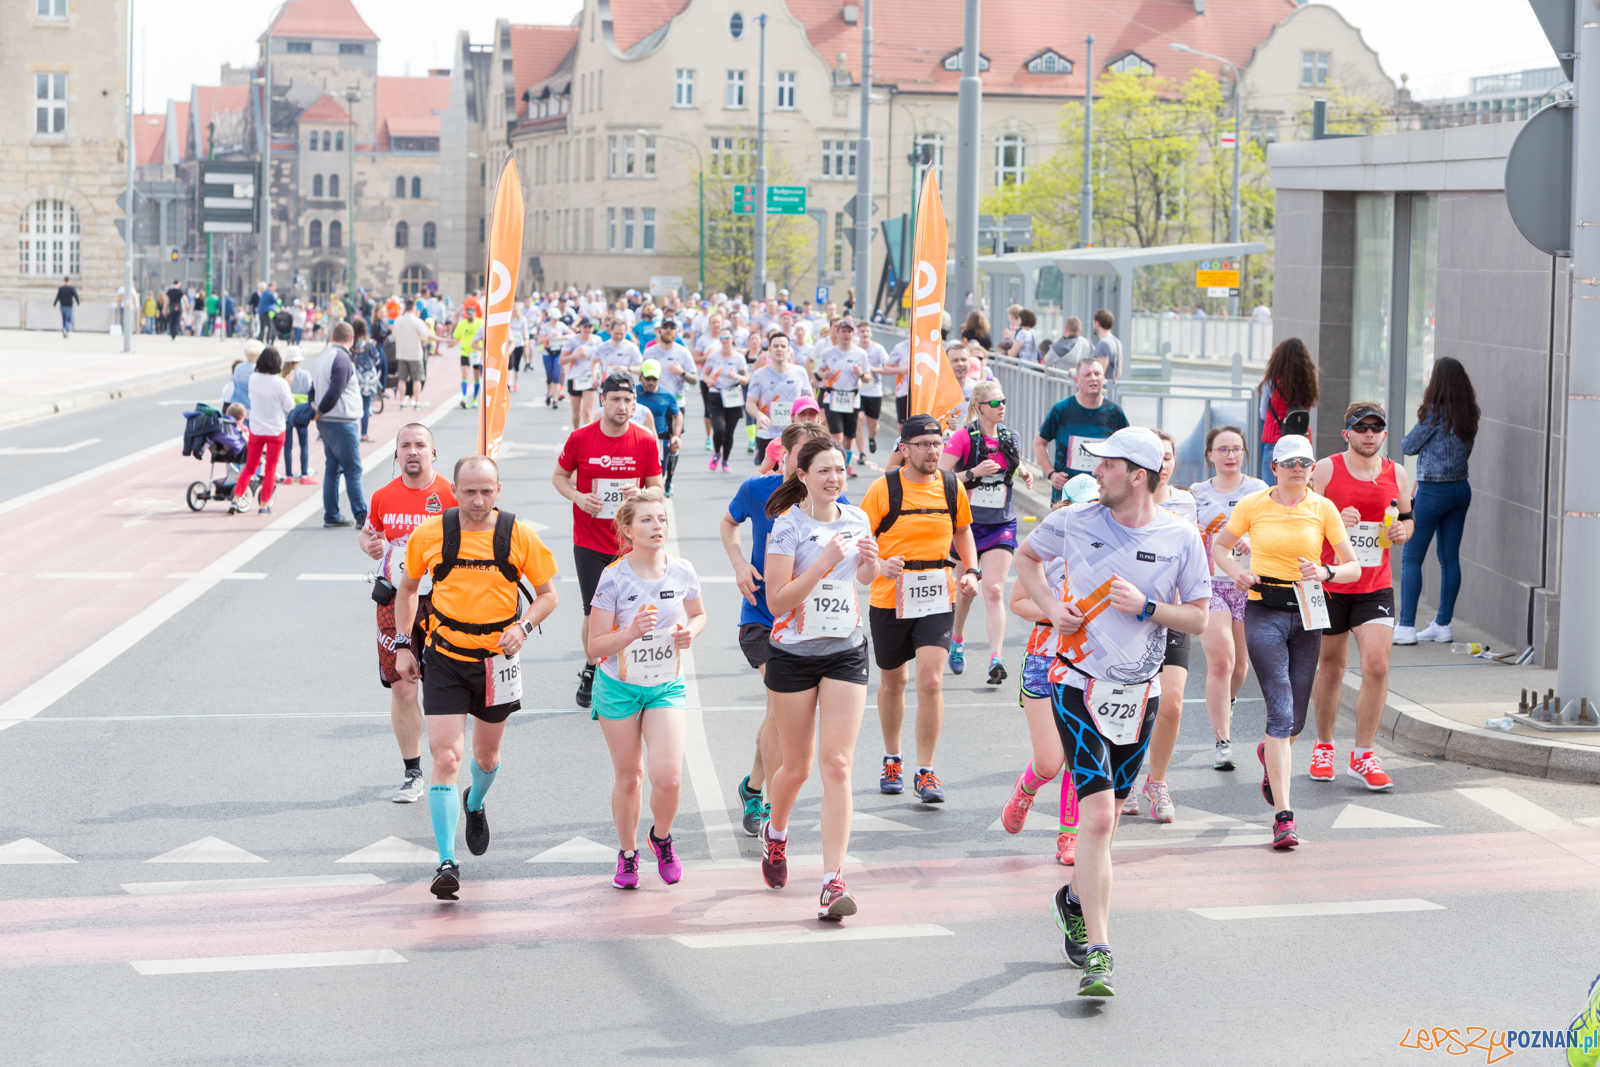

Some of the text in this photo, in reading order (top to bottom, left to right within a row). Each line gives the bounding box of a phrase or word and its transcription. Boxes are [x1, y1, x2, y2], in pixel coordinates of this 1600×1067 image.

[382, 513, 434, 525] ANAKON
[908, 584, 943, 598] 11551
[813, 597, 850, 613] 1924
[631, 645, 673, 663] 12166
[1097, 701, 1137, 719] 6728
